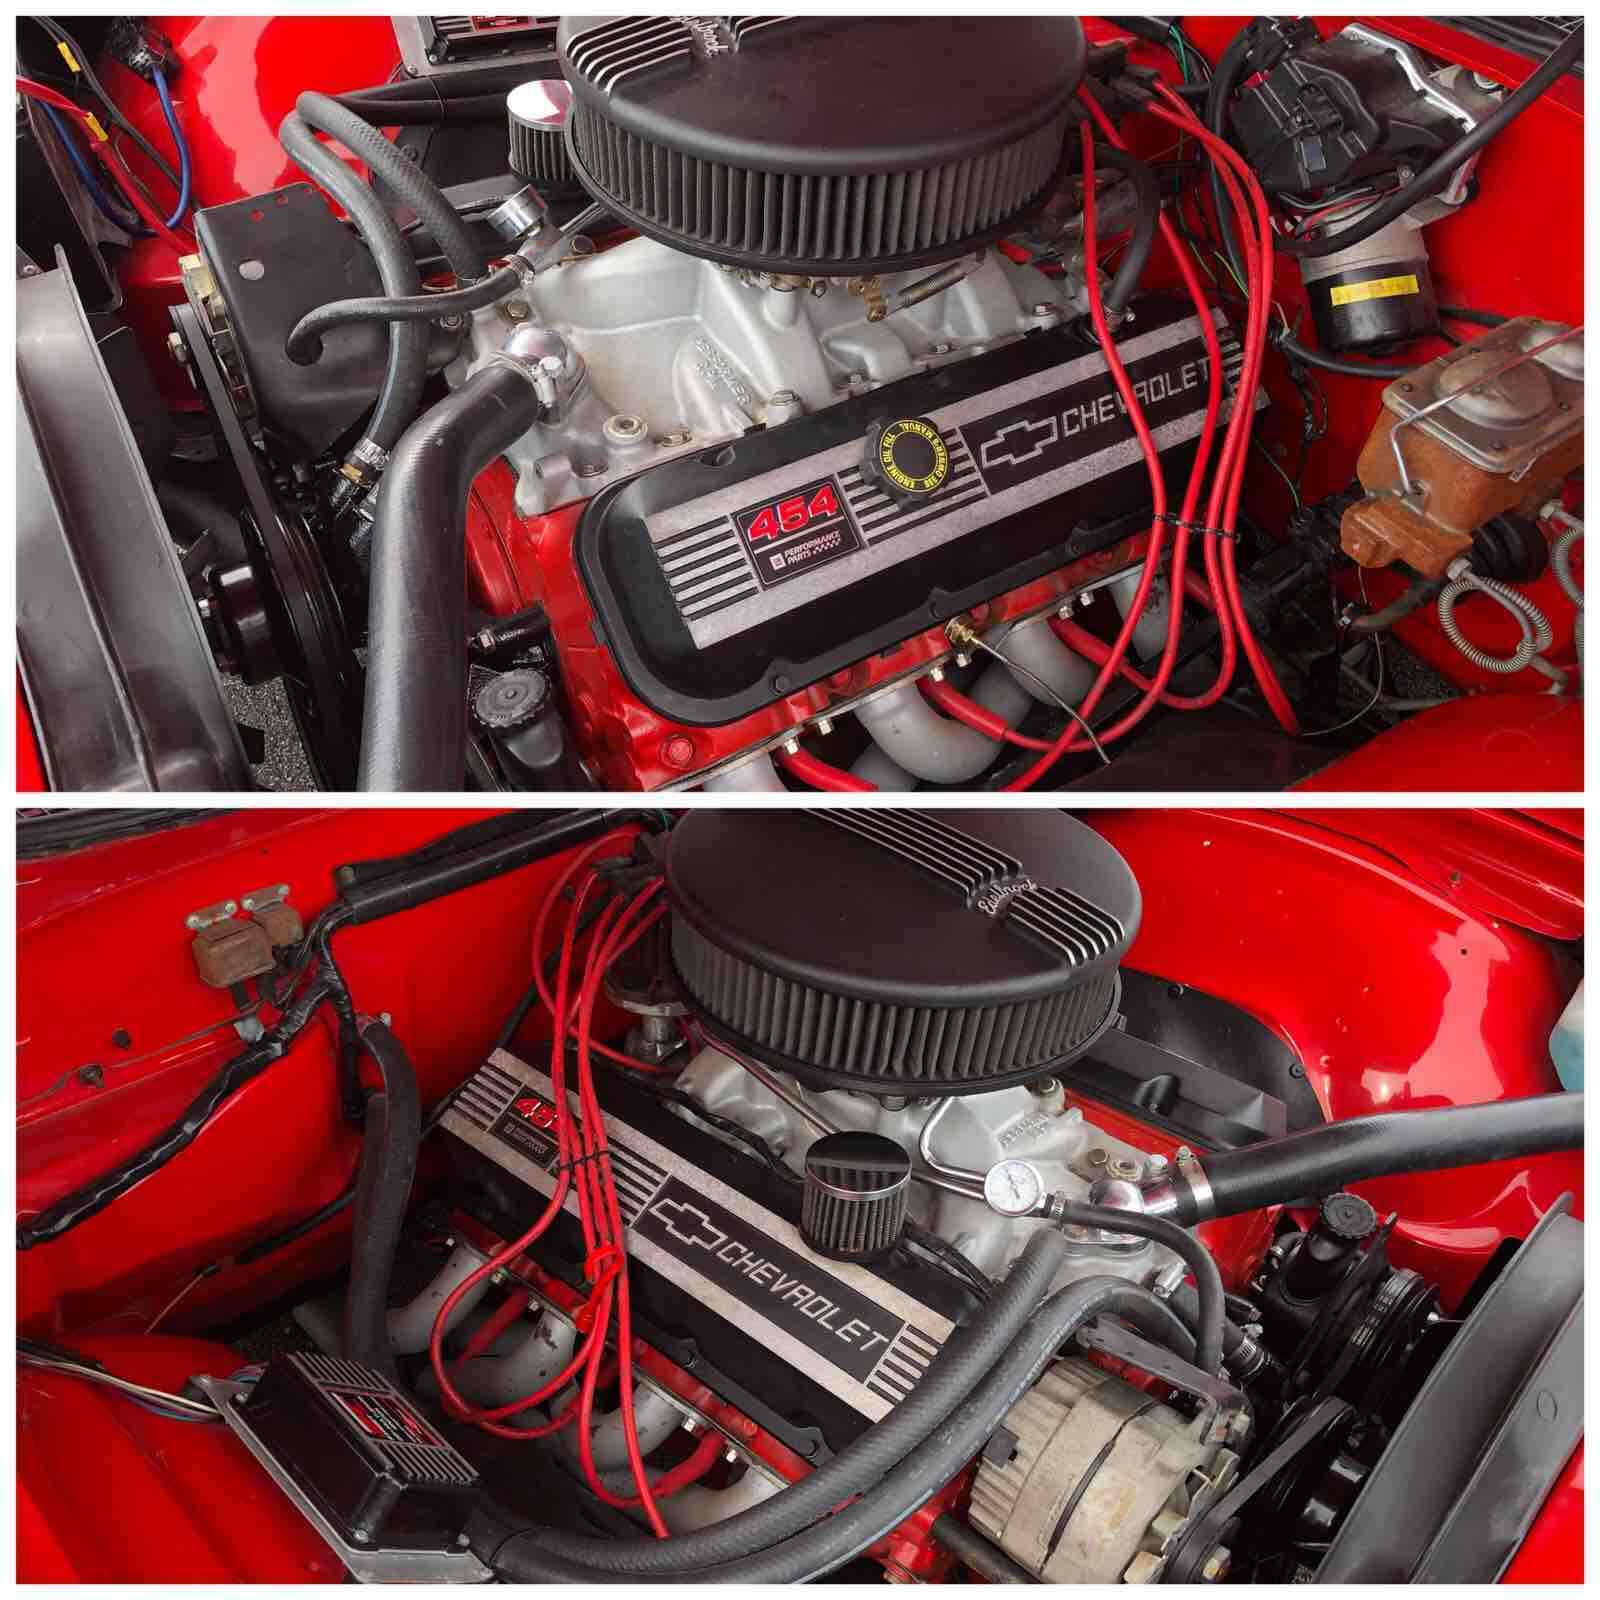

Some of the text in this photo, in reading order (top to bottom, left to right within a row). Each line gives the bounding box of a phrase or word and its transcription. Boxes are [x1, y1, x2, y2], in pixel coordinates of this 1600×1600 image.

[898, 422, 934, 438] MANUAL
[886, 464, 915, 489] ENGINE
[747, 485, 838, 542] 454
[716, 1241, 889, 1351] CHEVROLET
